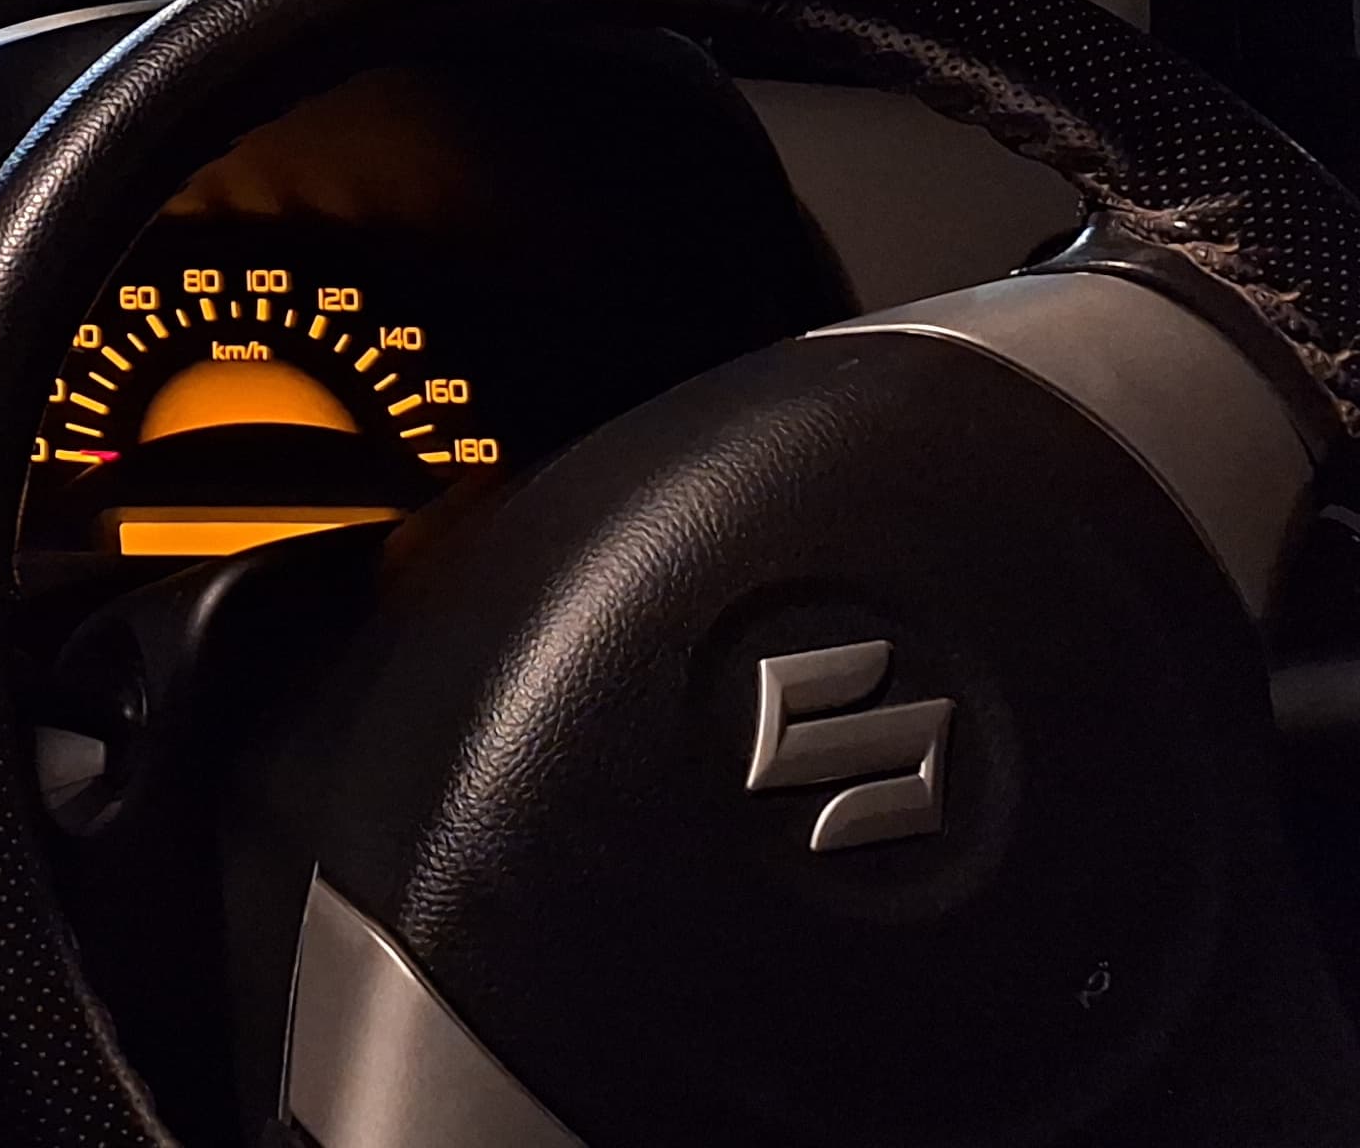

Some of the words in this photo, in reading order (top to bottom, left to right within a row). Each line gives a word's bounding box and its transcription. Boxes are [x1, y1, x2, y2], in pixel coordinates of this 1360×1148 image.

[184, 269, 221, 293] 80
[246, 269, 288, 293] 100
[120, 285, 158, 311] 60
[318, 287, 360, 312] 120
[73, 324, 101, 348] 0
[380, 326, 423, 351] 140
[212, 341, 270, 361] km/h
[425, 378, 469, 404] 160
[455, 438, 498, 463] 180
